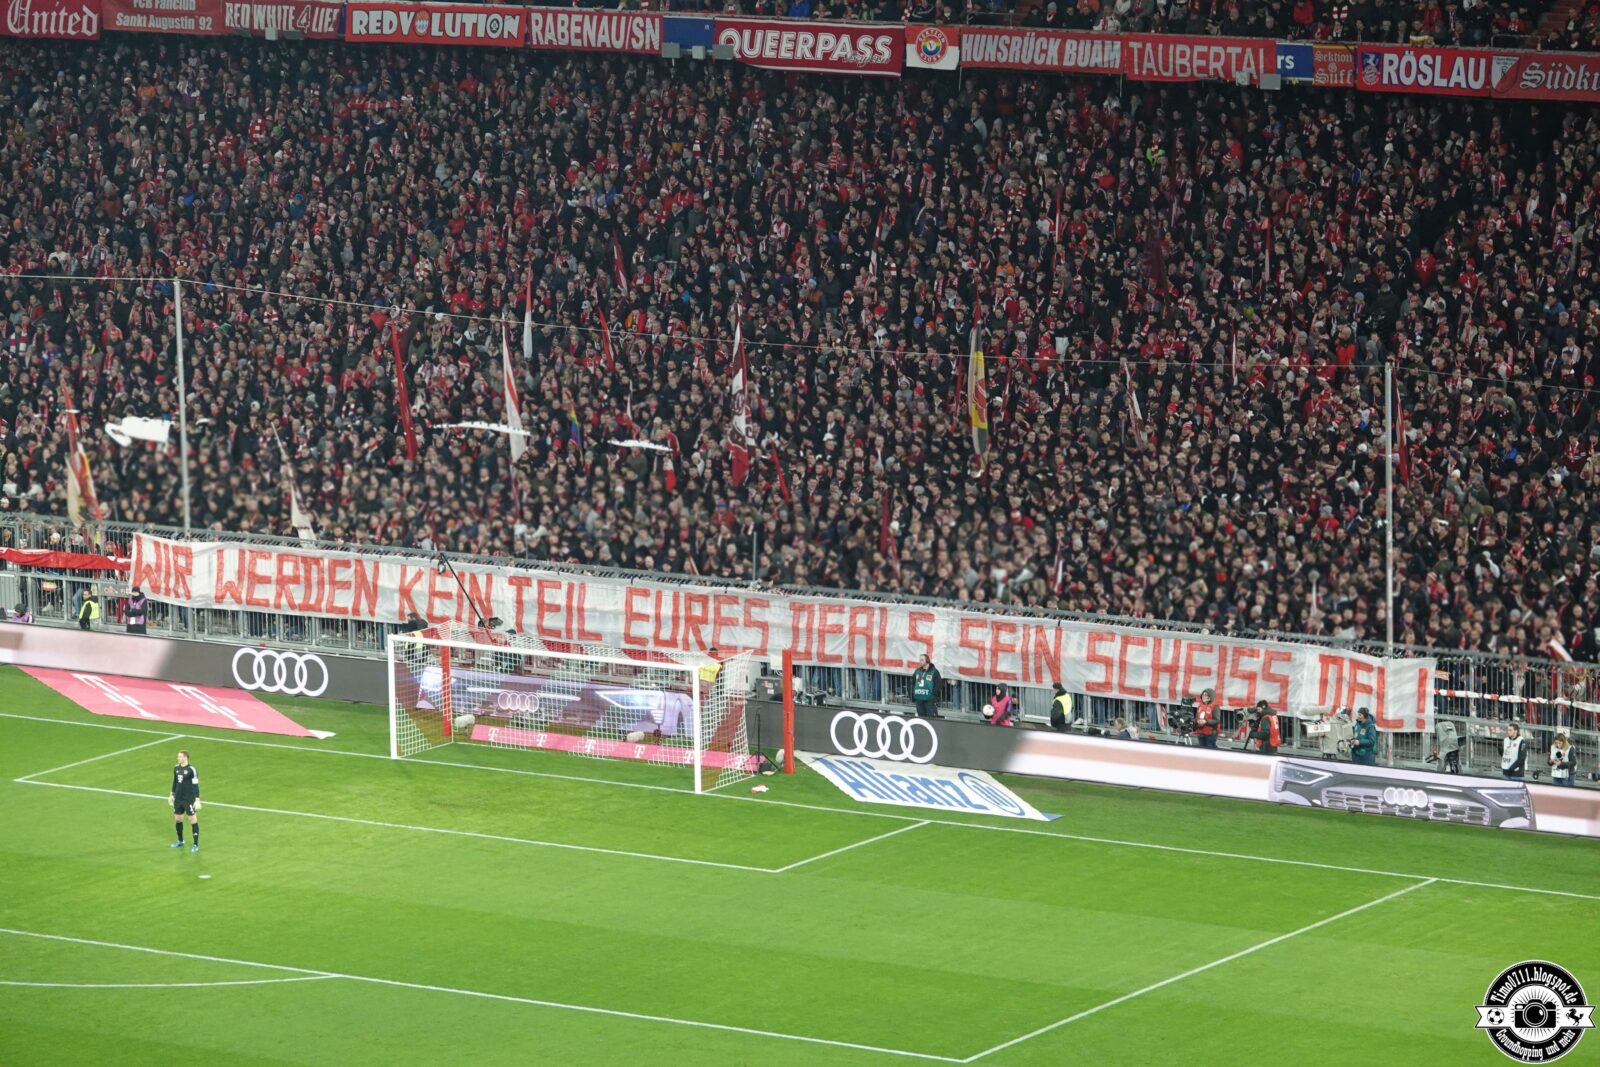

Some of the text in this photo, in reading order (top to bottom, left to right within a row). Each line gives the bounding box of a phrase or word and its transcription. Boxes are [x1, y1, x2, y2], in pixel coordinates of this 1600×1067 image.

[7, 0, 98, 36] United
[115, 12, 147, 28] Sankt
[148, 15, 196, 31] Augustin
[225, 2, 339, 33] RED WHITE 4 LIFE
[718, 27, 892, 62] QUEERPASS
[961, 32, 1122, 69] HUNSRÜCK BUAM
[1315, 50, 1352, 63] Sektion
[1382, 51, 1486, 89] RÖSLAU
[133, 534, 193, 600] WIR
[214, 548, 380, 617] WERDEN
[400, 564, 493, 624] KEIN
[508, 576, 603, 641] TEIL
[624, 587, 769, 656] EURES
[789, 602, 935, 668] DEALS
[958, 618, 1063, 684] SEIN
[1085, 631, 1292, 712] SCHEISS
[811, 754, 990, 811] Allianz
